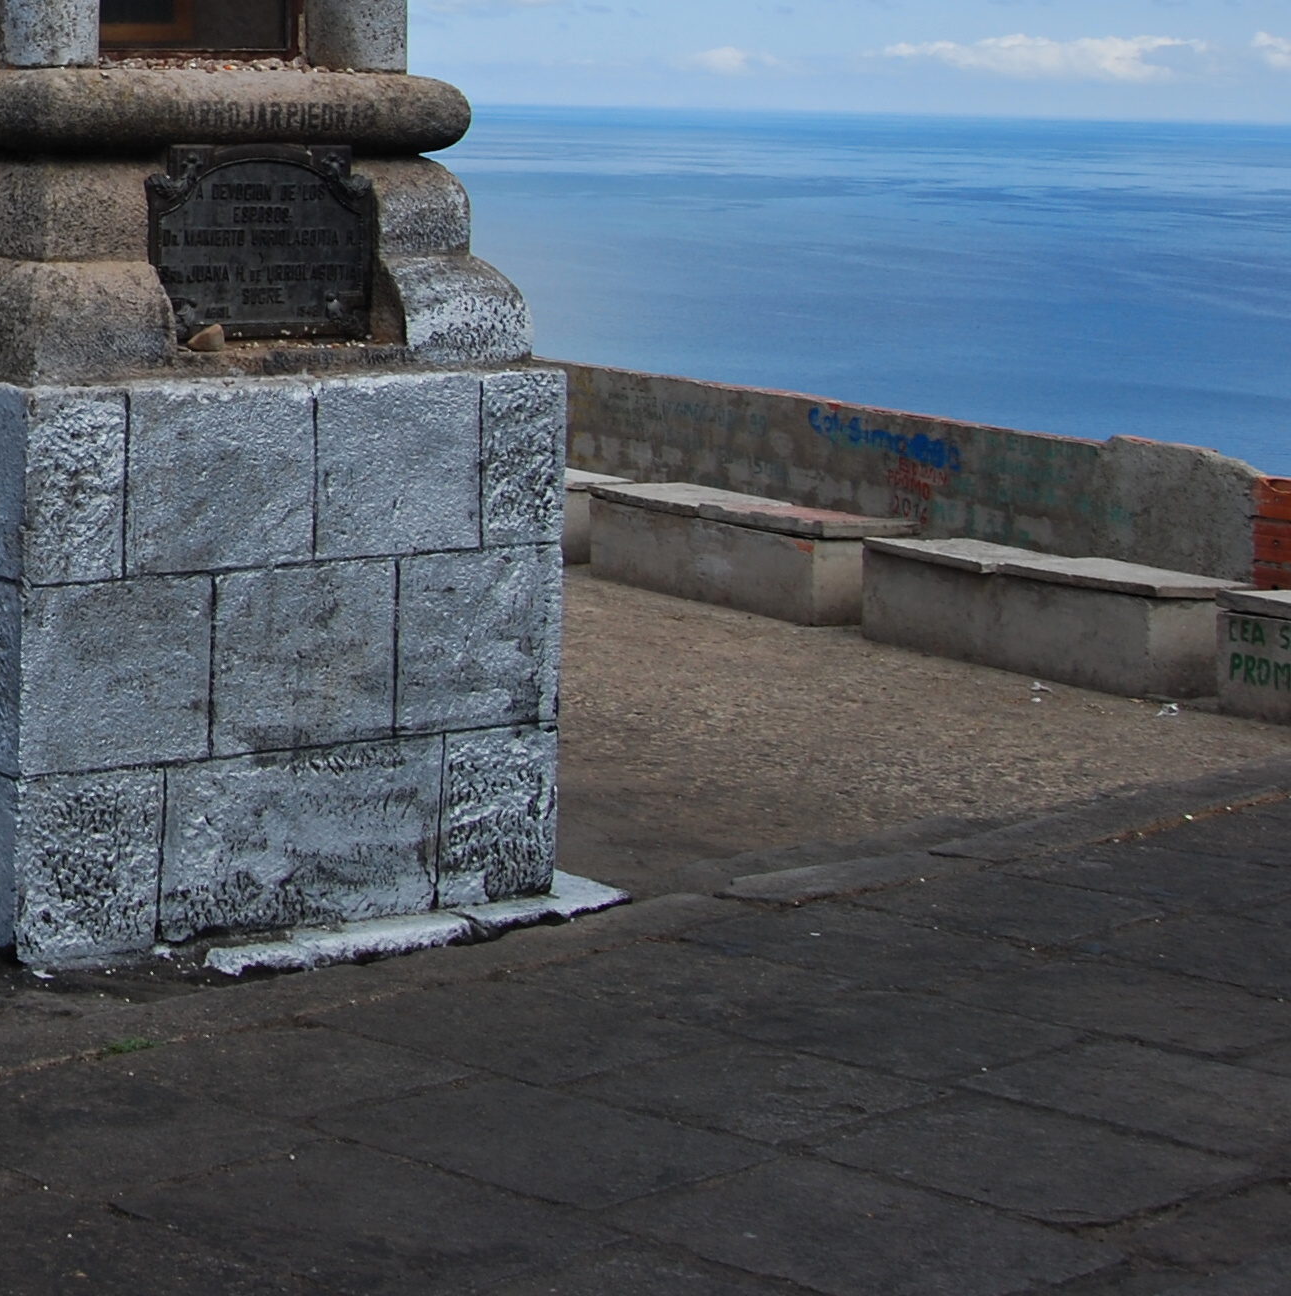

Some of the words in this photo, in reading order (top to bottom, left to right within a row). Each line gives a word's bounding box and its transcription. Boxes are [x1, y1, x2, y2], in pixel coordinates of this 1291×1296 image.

[195, 183, 204, 200] A
[212, 183, 272, 201] DEVOCION
[280, 184, 296, 201] DE
[303, 184, 325, 201] LOS
[186, 265, 230, 283] JUANA
[242, 287, 285, 305] SUCRE
